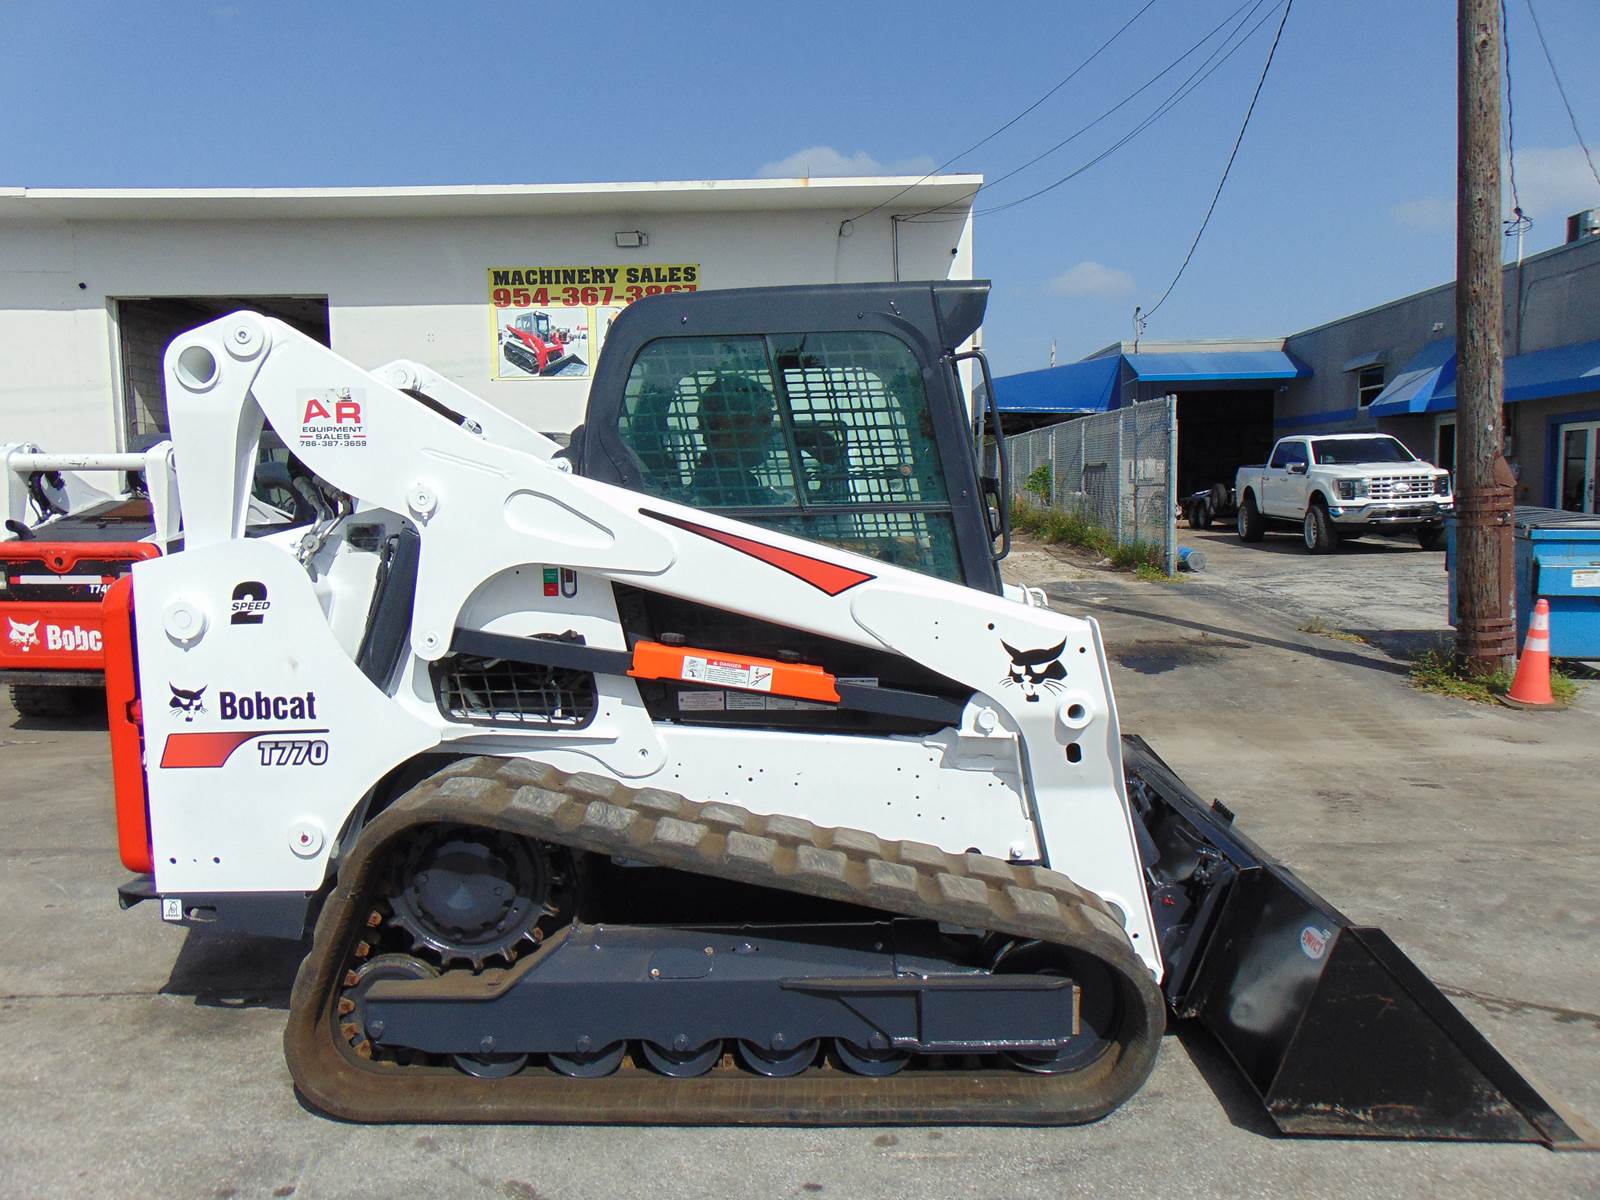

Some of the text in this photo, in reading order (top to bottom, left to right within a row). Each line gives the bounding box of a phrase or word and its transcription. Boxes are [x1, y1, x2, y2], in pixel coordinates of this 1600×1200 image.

[493, 266, 697, 286] MACHINERY SALES
[89, 584, 112, 594] T74
[231, 601, 271, 611] SPEED
[219, 691, 317, 721] Bobcat
[257, 740, 329, 766] T770
